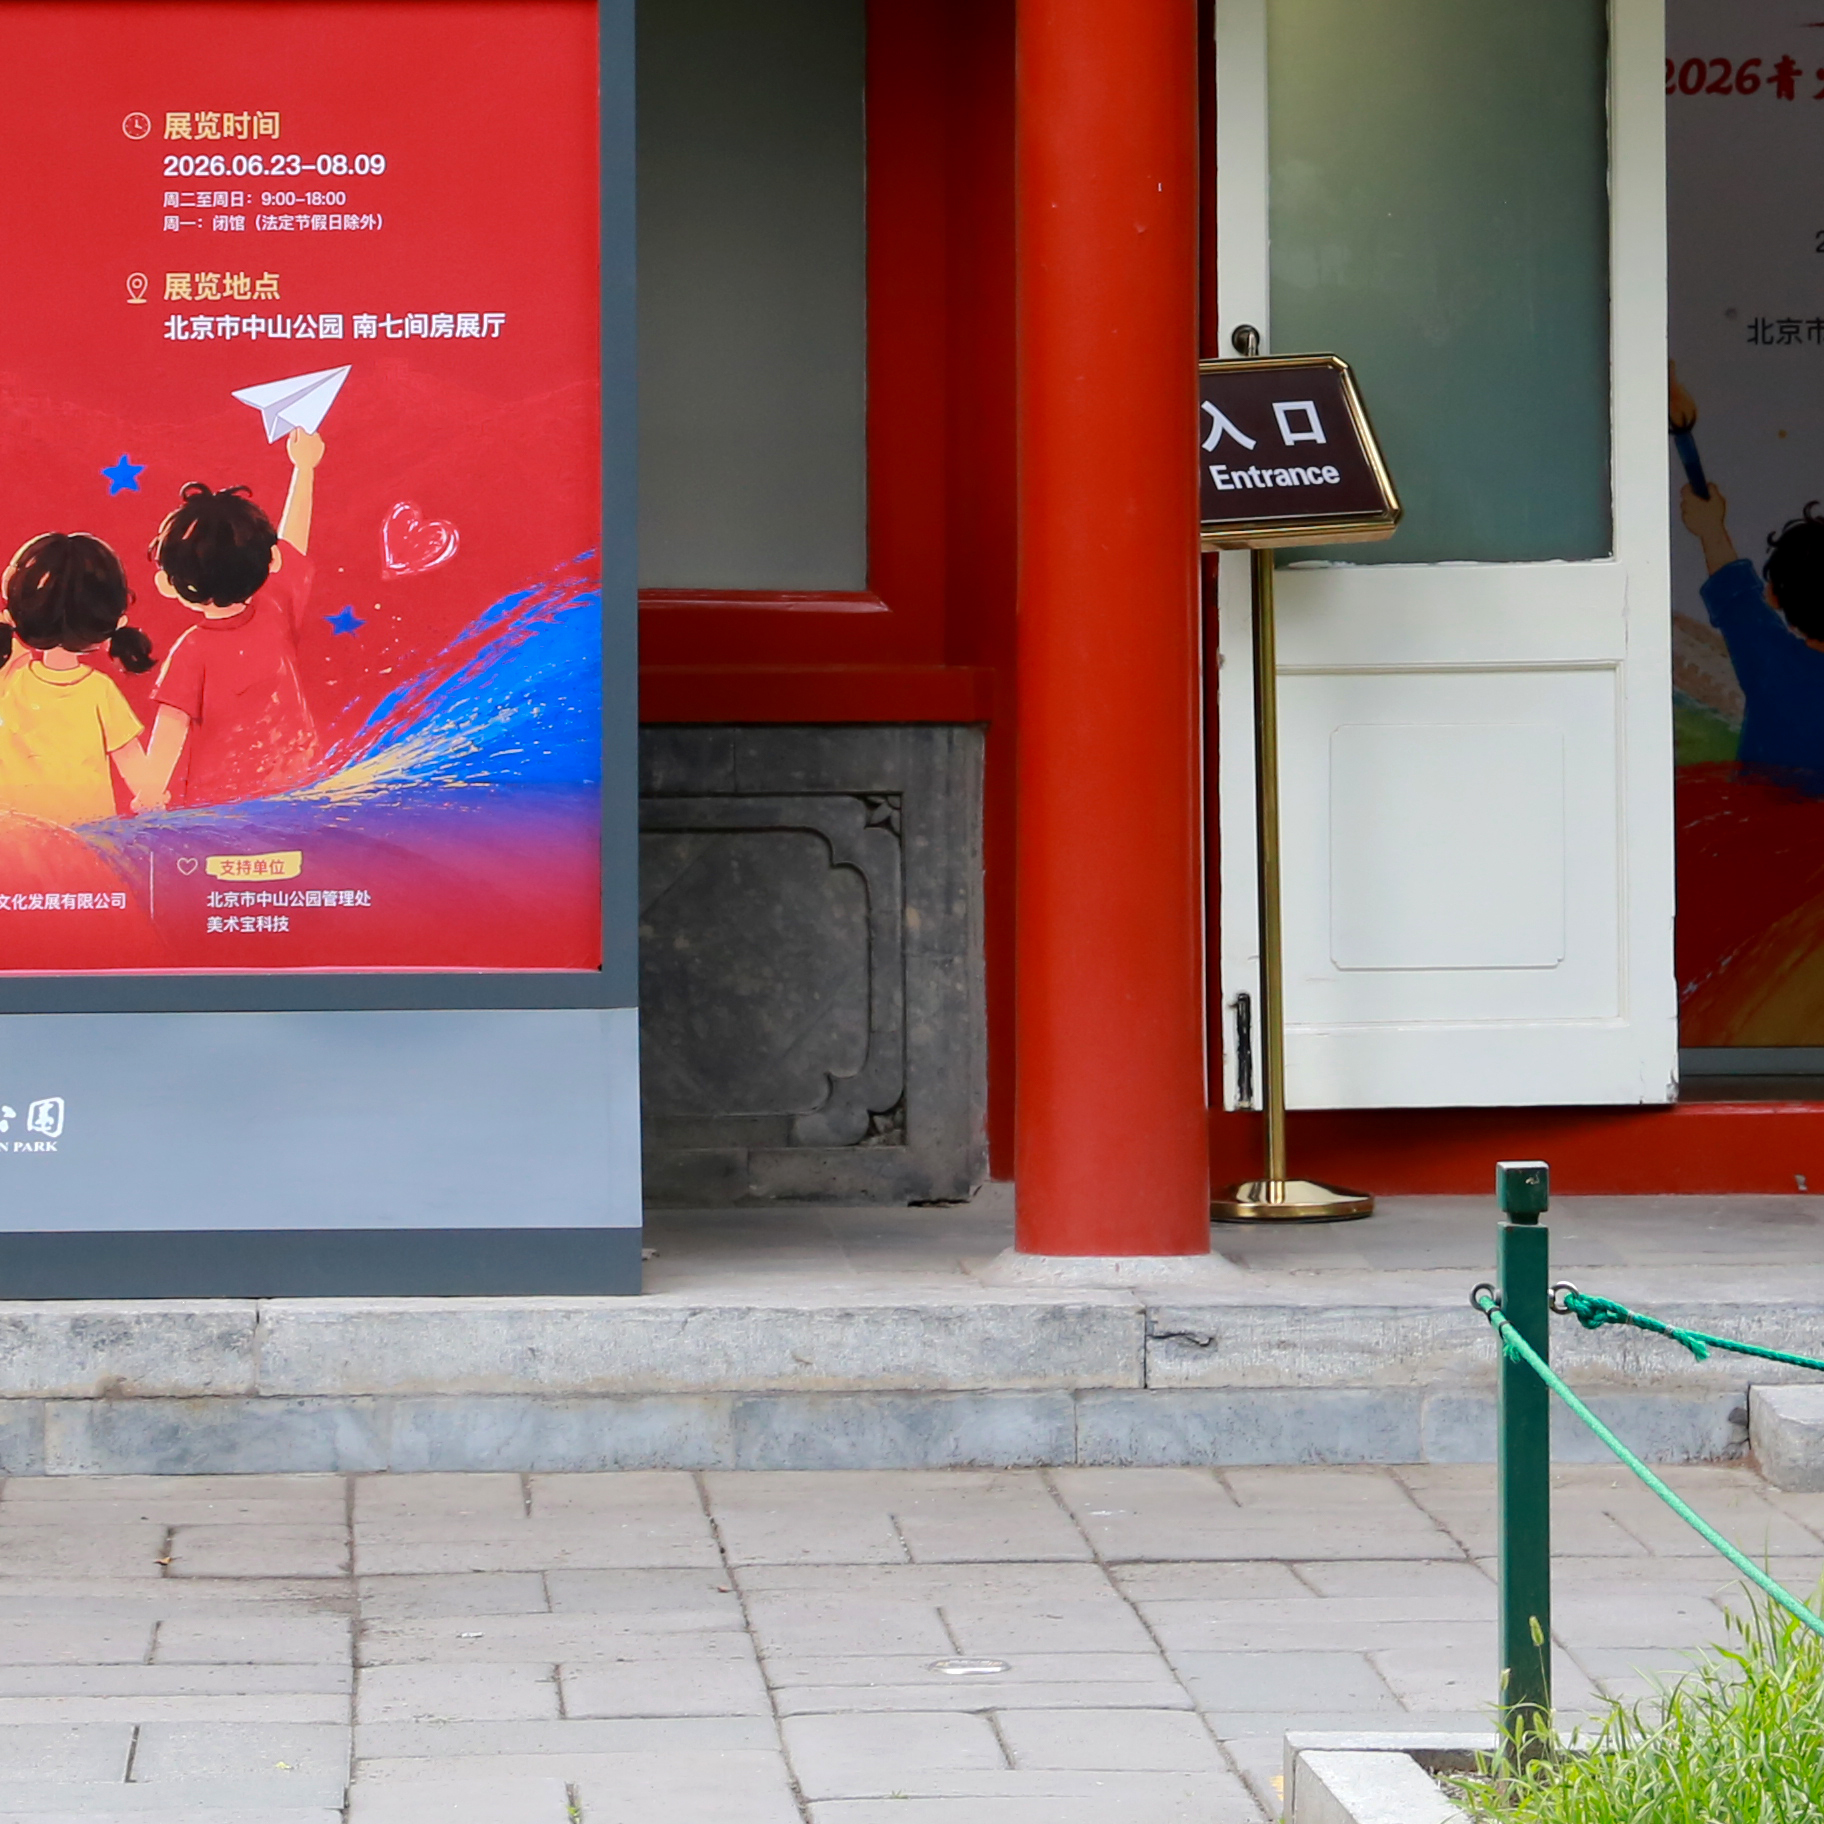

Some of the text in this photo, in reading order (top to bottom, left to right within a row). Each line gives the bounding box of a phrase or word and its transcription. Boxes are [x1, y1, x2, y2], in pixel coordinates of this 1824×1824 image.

[163, 111, 280, 140] 展览时间
[163, 272, 281, 301] 展览地点
[164, 312, 506, 341] 北京市中山公园 南七间房展厅
[1201, 400, 1327, 453] 入口
[1209, 464, 1341, 491] Entrance
[219, 859, 286, 876] 支持单位
[206, 889, 371, 908] 北京市中山公园管理处
[207, 916, 289, 933] 美术宝科技
[13, 1141, 58, 1152] PARK
